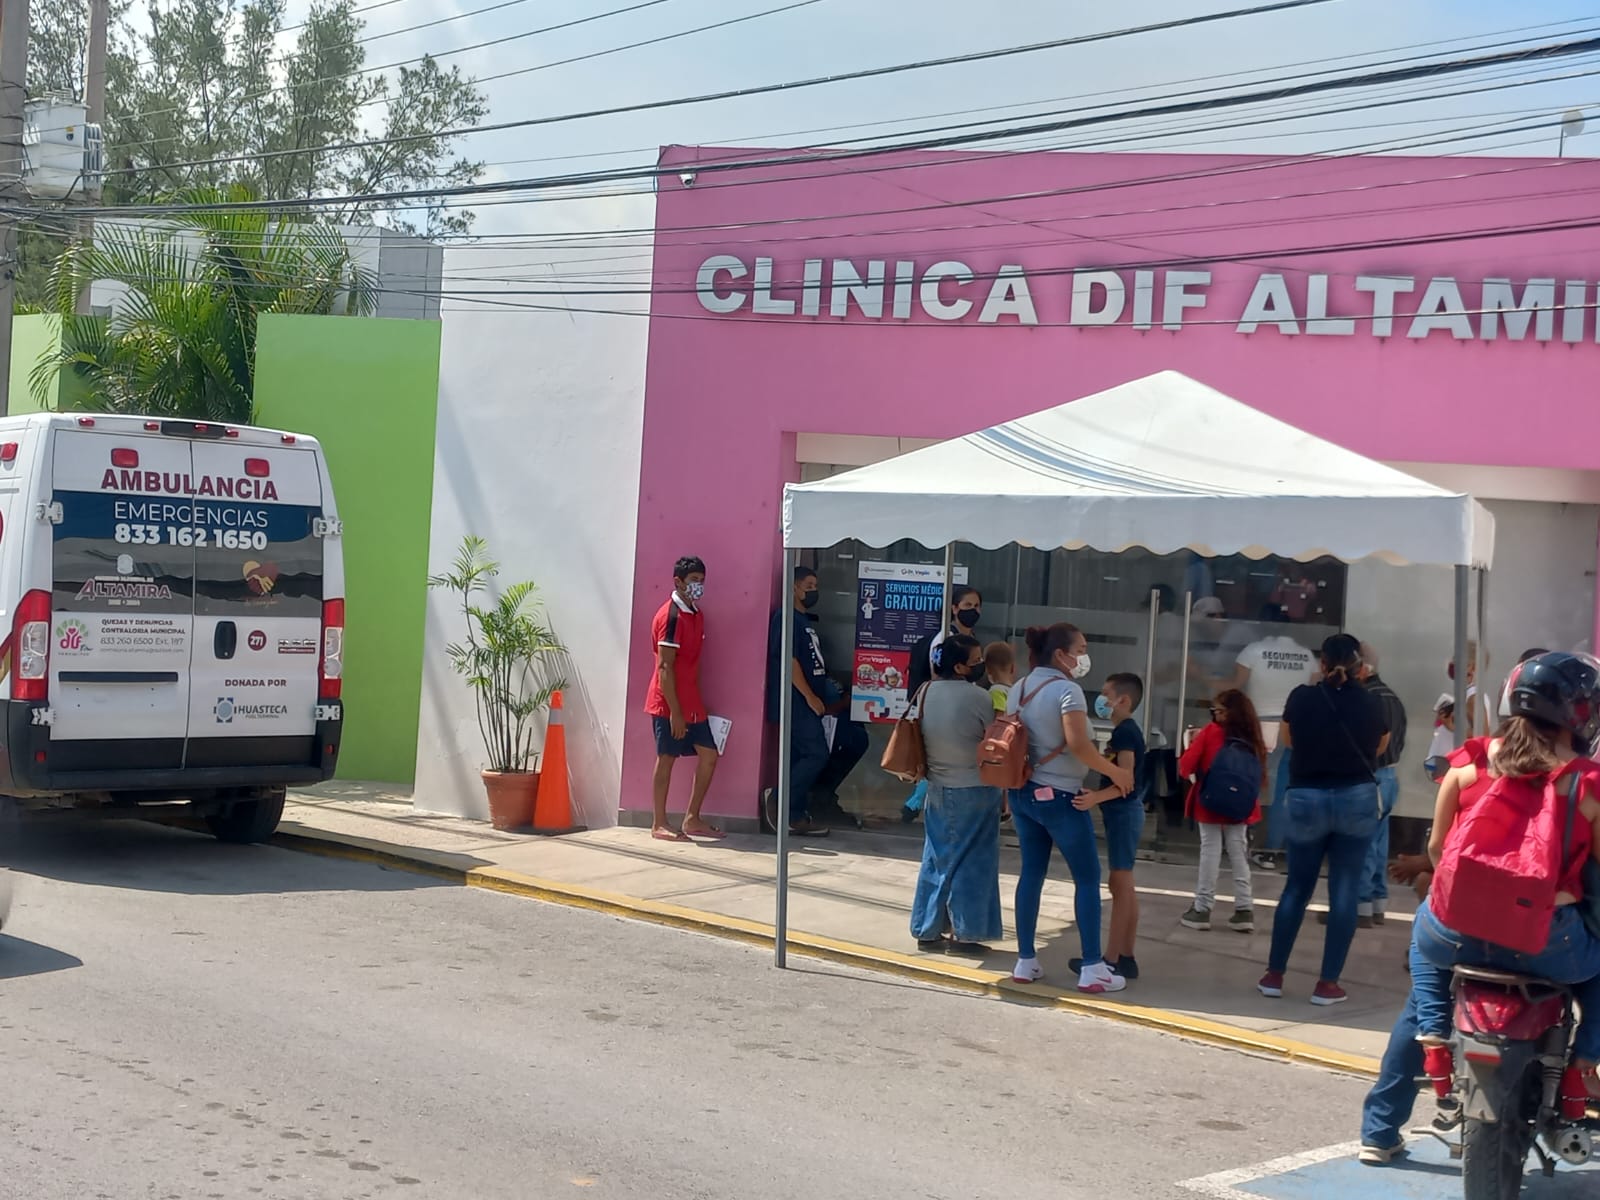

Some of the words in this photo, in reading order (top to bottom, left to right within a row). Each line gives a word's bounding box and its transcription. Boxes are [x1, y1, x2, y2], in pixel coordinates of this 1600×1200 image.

[695, 255, 1039, 326] CLINICA
[1070, 267, 1212, 332] DIF
[1235, 273, 1600, 344] ALTAMI
[101, 469, 279, 501] AMBULANCIA
[114, 501, 269, 528] EMERGENCIAS
[114, 523, 161, 545] 833
[167, 526, 208, 547] 162
[213, 529, 268, 550] 1650
[75, 578, 173, 600] ALTAMIRA
[863, 588, 876, 597] 79
[884, 583, 920, 594] SERVICIOS
[921, 584, 945, 596] MÉDIC
[884, 595, 943, 611] GRATUITO
[1262, 651, 1309, 662] SEGURIDAD
[1267, 661, 1304, 671] PRIVADA
[224, 679, 266, 688] DONADA
[267, 679, 288, 688] POR
[237, 705, 288, 714] HUASTECA
